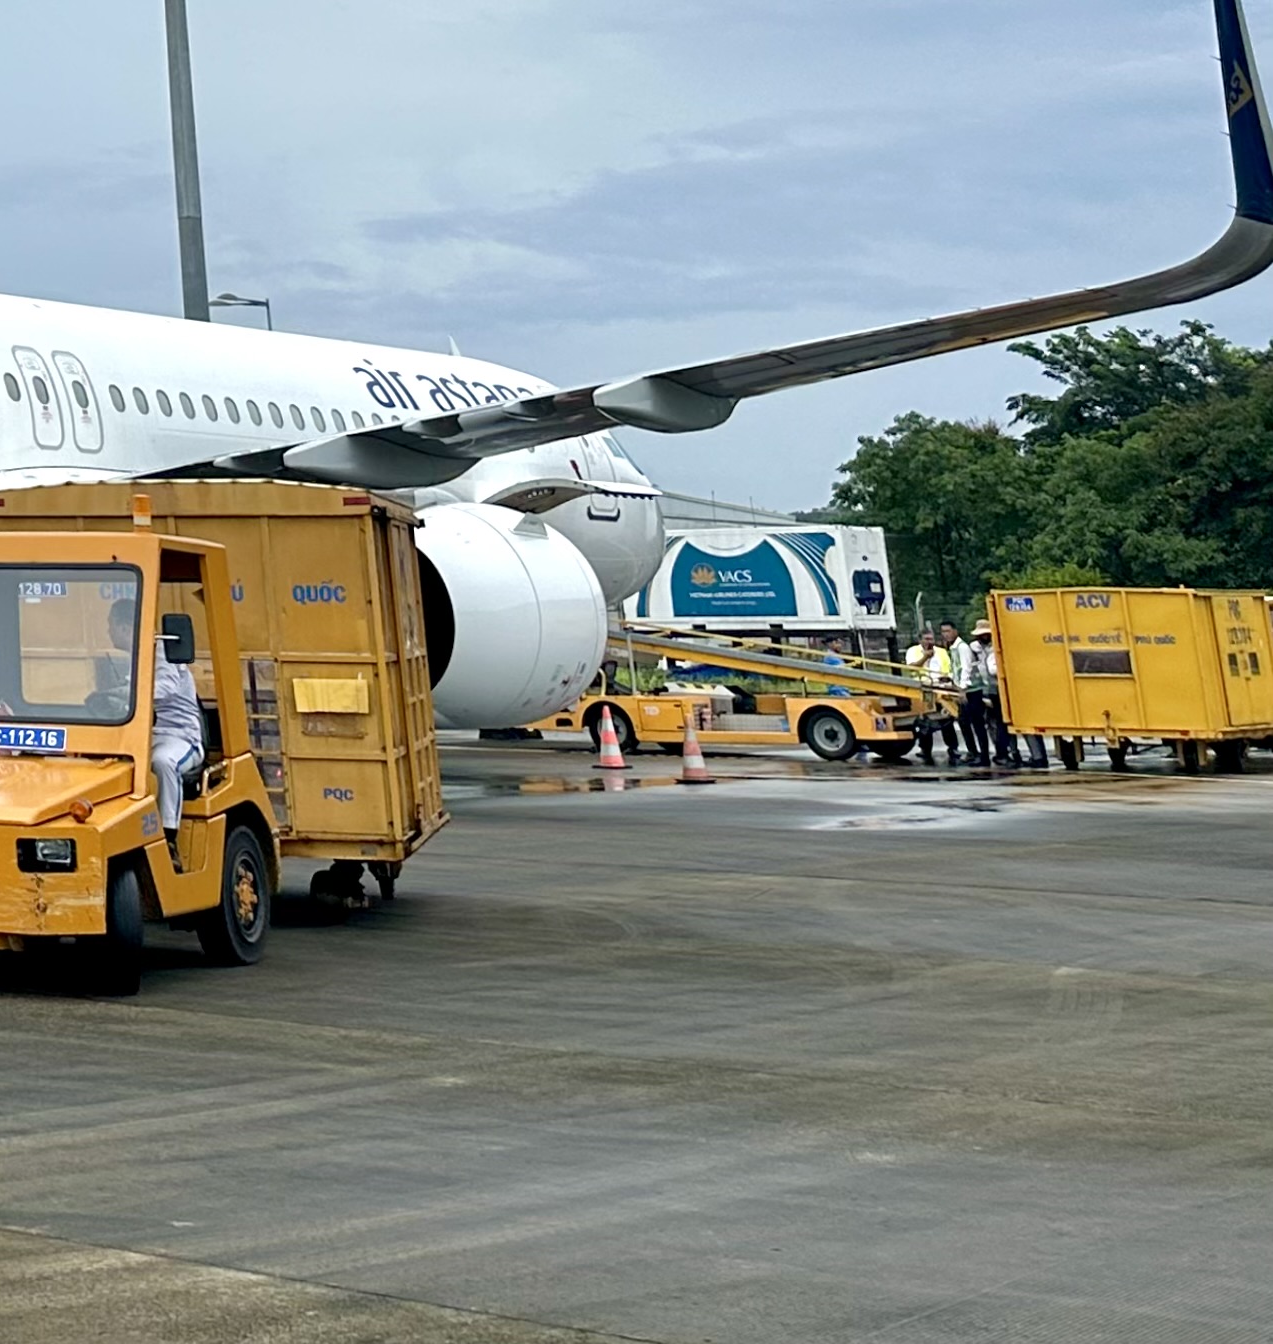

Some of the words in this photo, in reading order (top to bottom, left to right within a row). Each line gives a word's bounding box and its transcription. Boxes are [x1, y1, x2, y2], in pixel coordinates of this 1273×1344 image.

[352, 358, 421, 411] air
[717, 569, 752, 583] VACS
[292, 579, 346, 605] QUỐC
[1075, 594, 1111, 609] ACV
[322, 787, 354, 803] PQC
